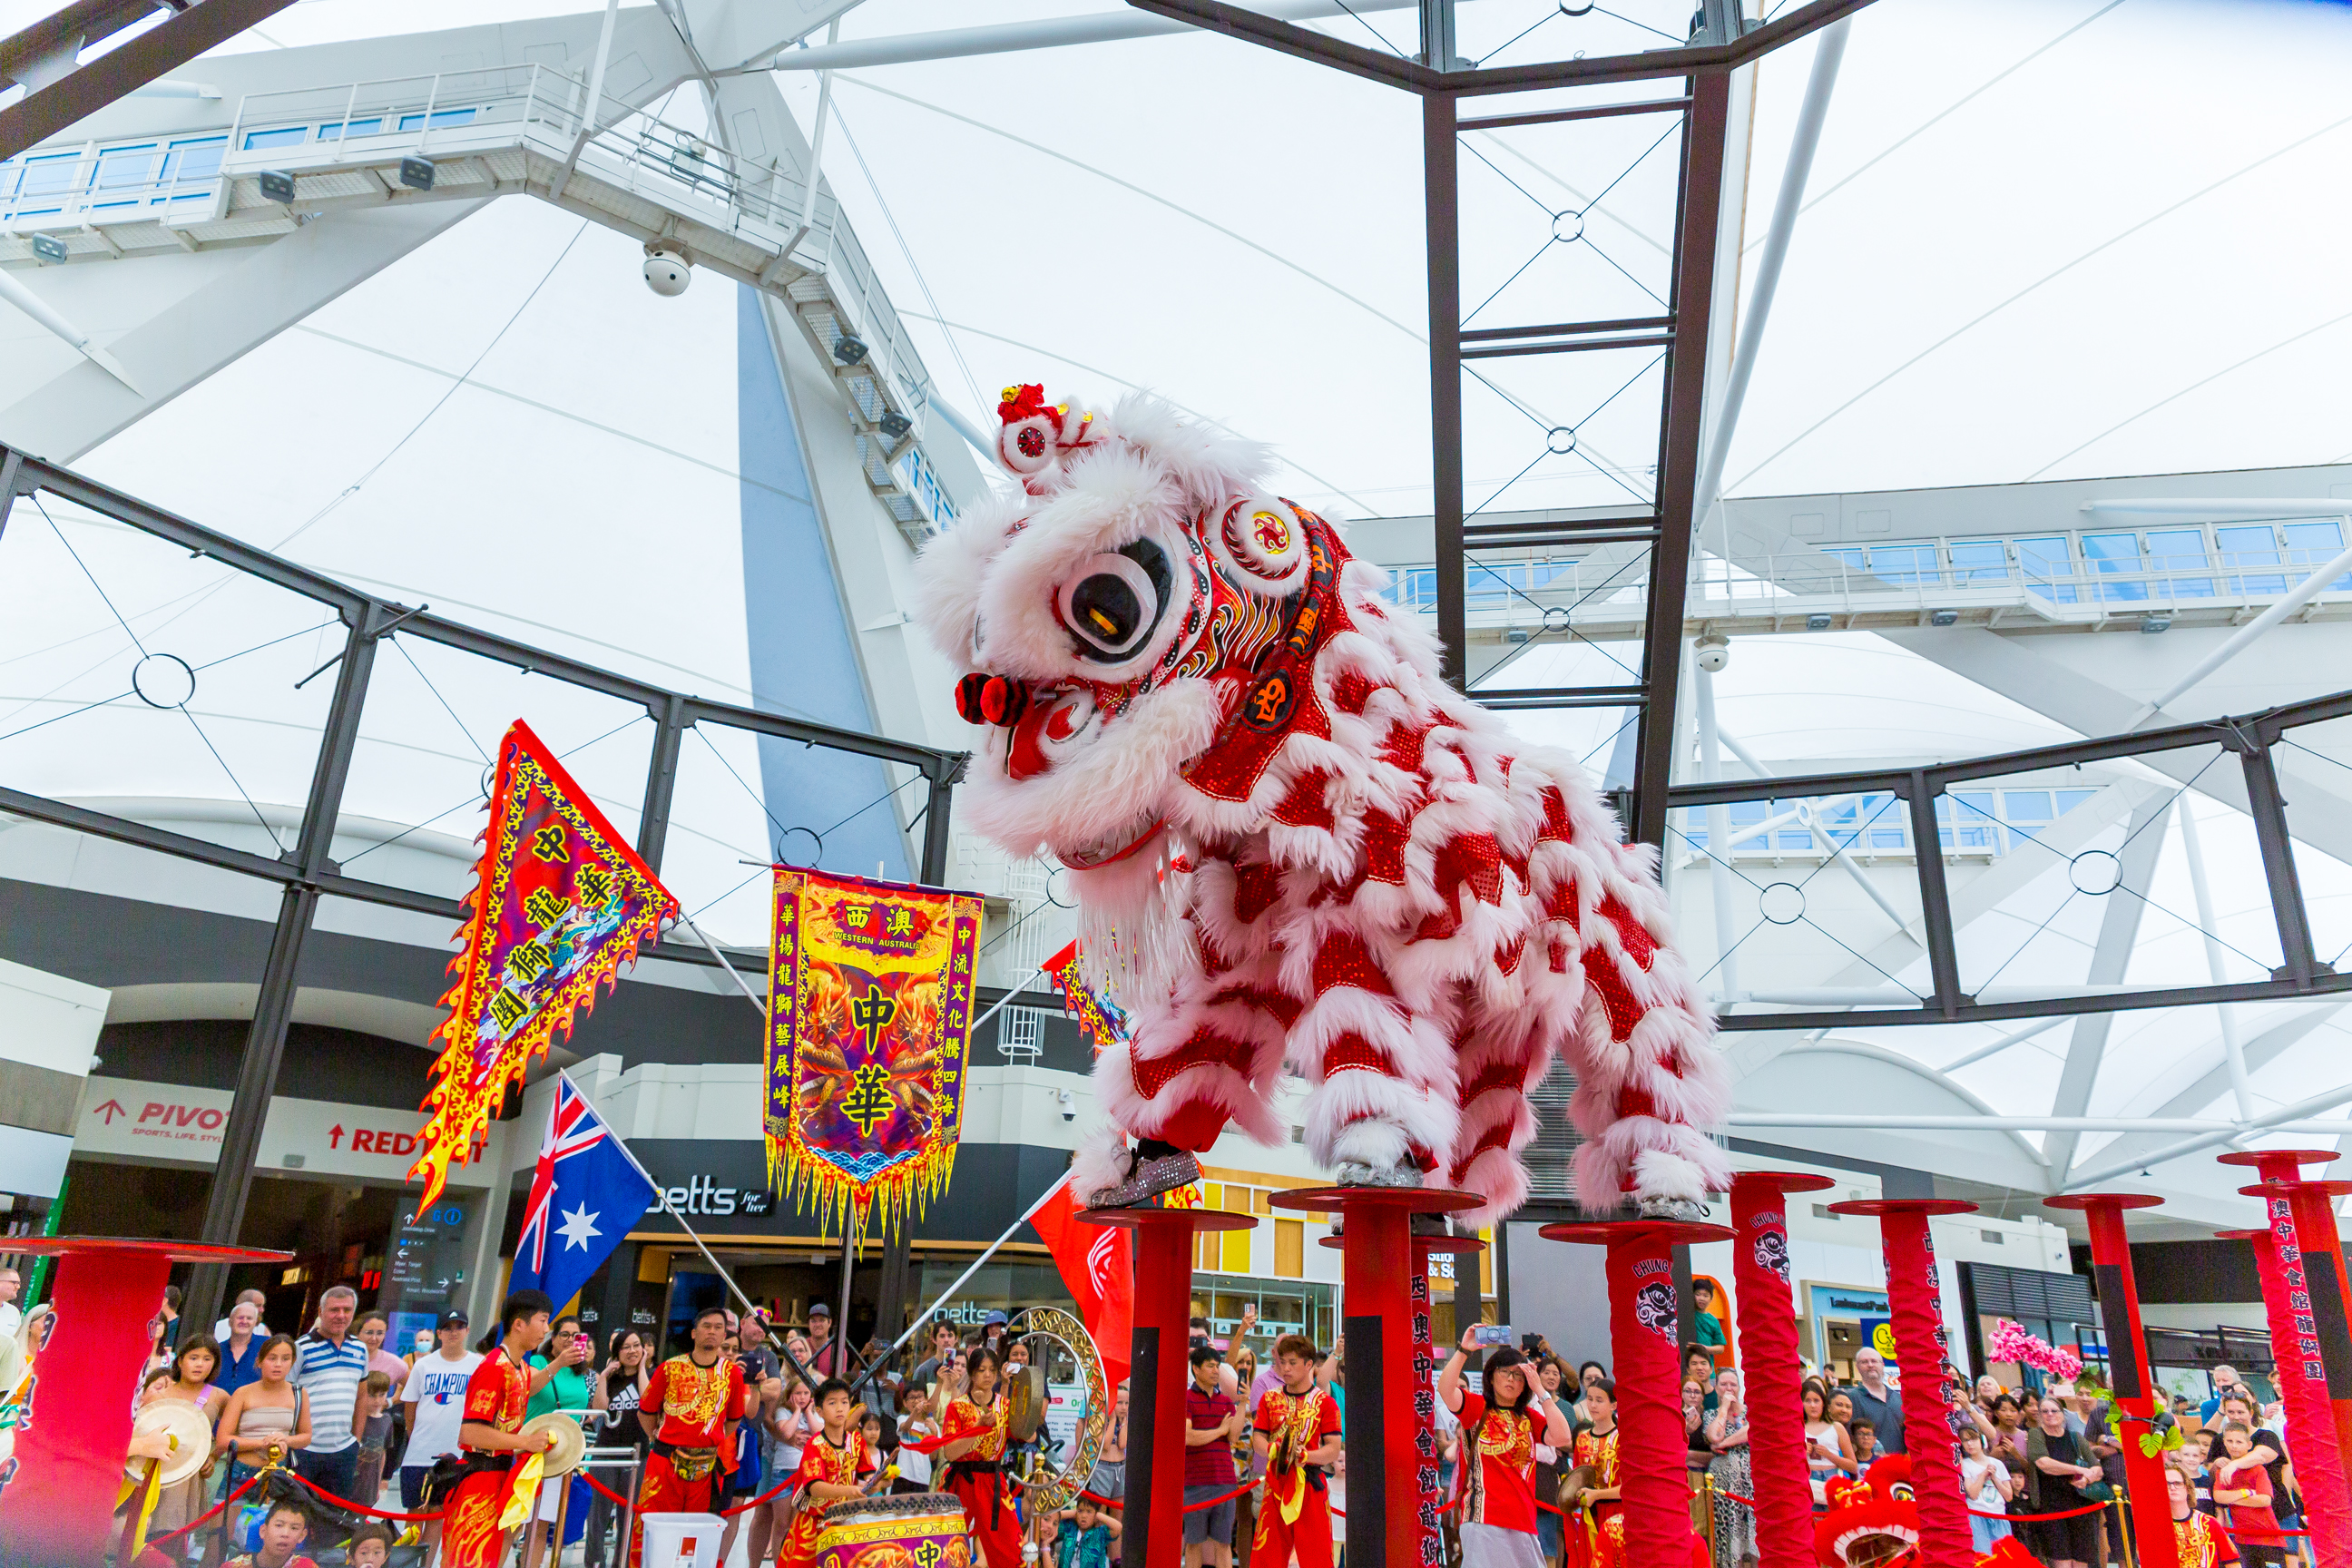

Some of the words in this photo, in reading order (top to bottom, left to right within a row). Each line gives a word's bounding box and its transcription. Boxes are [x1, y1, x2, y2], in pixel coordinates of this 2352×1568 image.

[845, 905, 914, 937] 西澳
[833, 931, 874, 946] WESTERN
[878, 938, 920, 951] AUSTRALIA
[840, 984, 897, 1137] 中華
[200, 1134, 223, 1143] STYL
[350, 1128, 416, 1156] RED
[740, 1191, 761, 1205] for
[745, 1201, 767, 1212] her
[1749, 1211, 1779, 1229] CHUNG
[1427, 1262, 1439, 1278] &
[1632, 1258, 1669, 1279] CHUNG
[424, 1373, 472, 1396] CHAMPION
[609, 1399, 641, 1411] adida
